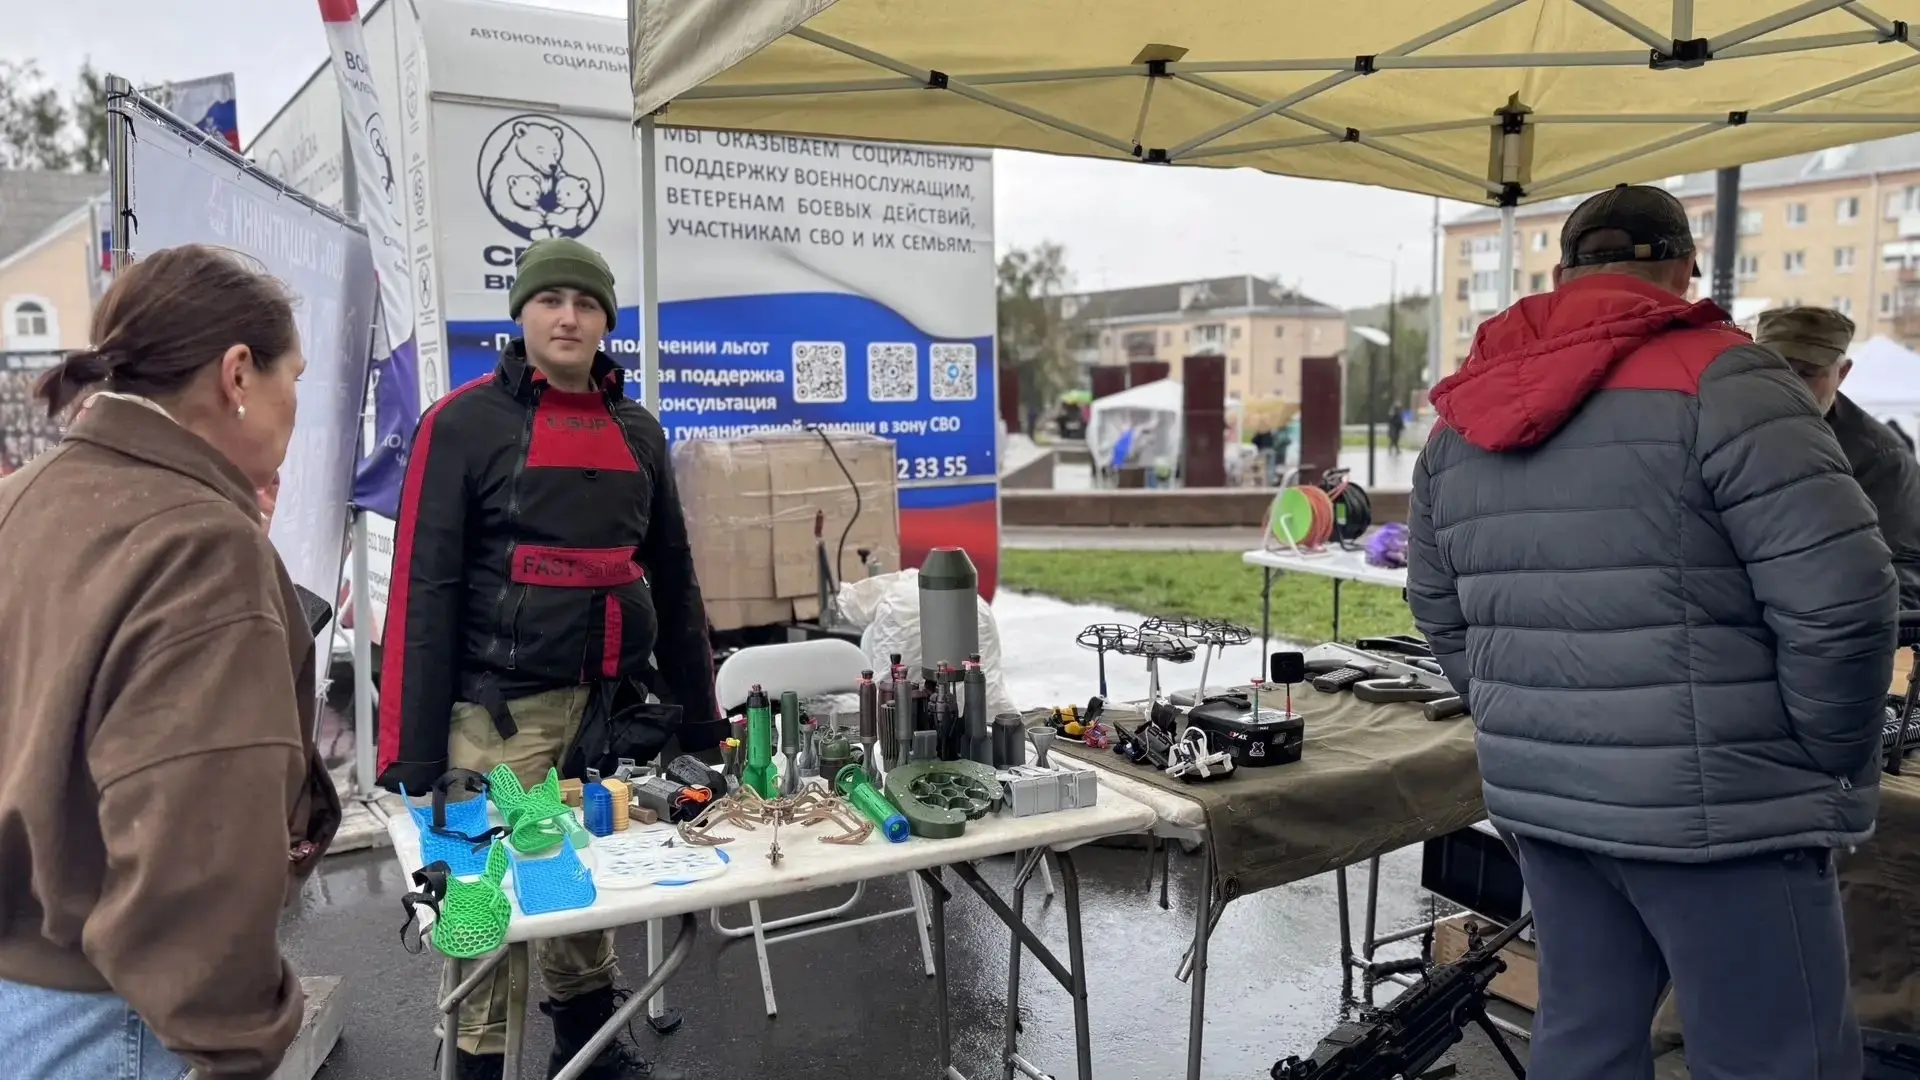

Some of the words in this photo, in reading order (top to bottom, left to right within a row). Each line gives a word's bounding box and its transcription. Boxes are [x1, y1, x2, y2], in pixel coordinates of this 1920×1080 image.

[470, 27, 583, 51] АВТОНОМНАЯ
[543, 52, 629, 74] СОЦИАЛЬН
[664, 128, 702, 145] МЫ
[716, 131, 839, 159] ОКАЗЫВАЕМ
[852, 143, 974, 173] СОЦИАЛЬНУЮ
[664, 155, 790, 184] ПОДДЕРЖКУ
[794, 167, 976, 202] ВОЕННОСЛУЖАЩИМ,
[666, 186, 785, 213] ВЕТЕРЕНАМ
[798, 197, 872, 220] БОЕВЫХ
[882, 202, 976, 230] ДЕЙСТВИЙ,
[667, 217, 801, 243] УЧАСТНИКАМ
[809, 227, 845, 246] СВО
[852, 231, 864, 247] И
[872, 232, 895, 249] ИХ
[902, 233, 976, 254] СЕМЬЯМ.
[611, 338, 717, 356] почении
[720, 340, 770, 356] льгот
[681, 368, 785, 387] поддержка
[879, 421, 889, 434] в
[891, 420, 928, 437] зону
[930, 416, 961, 432] СВО
[915, 456, 939, 478] 33
[944, 455, 968, 477] 55
